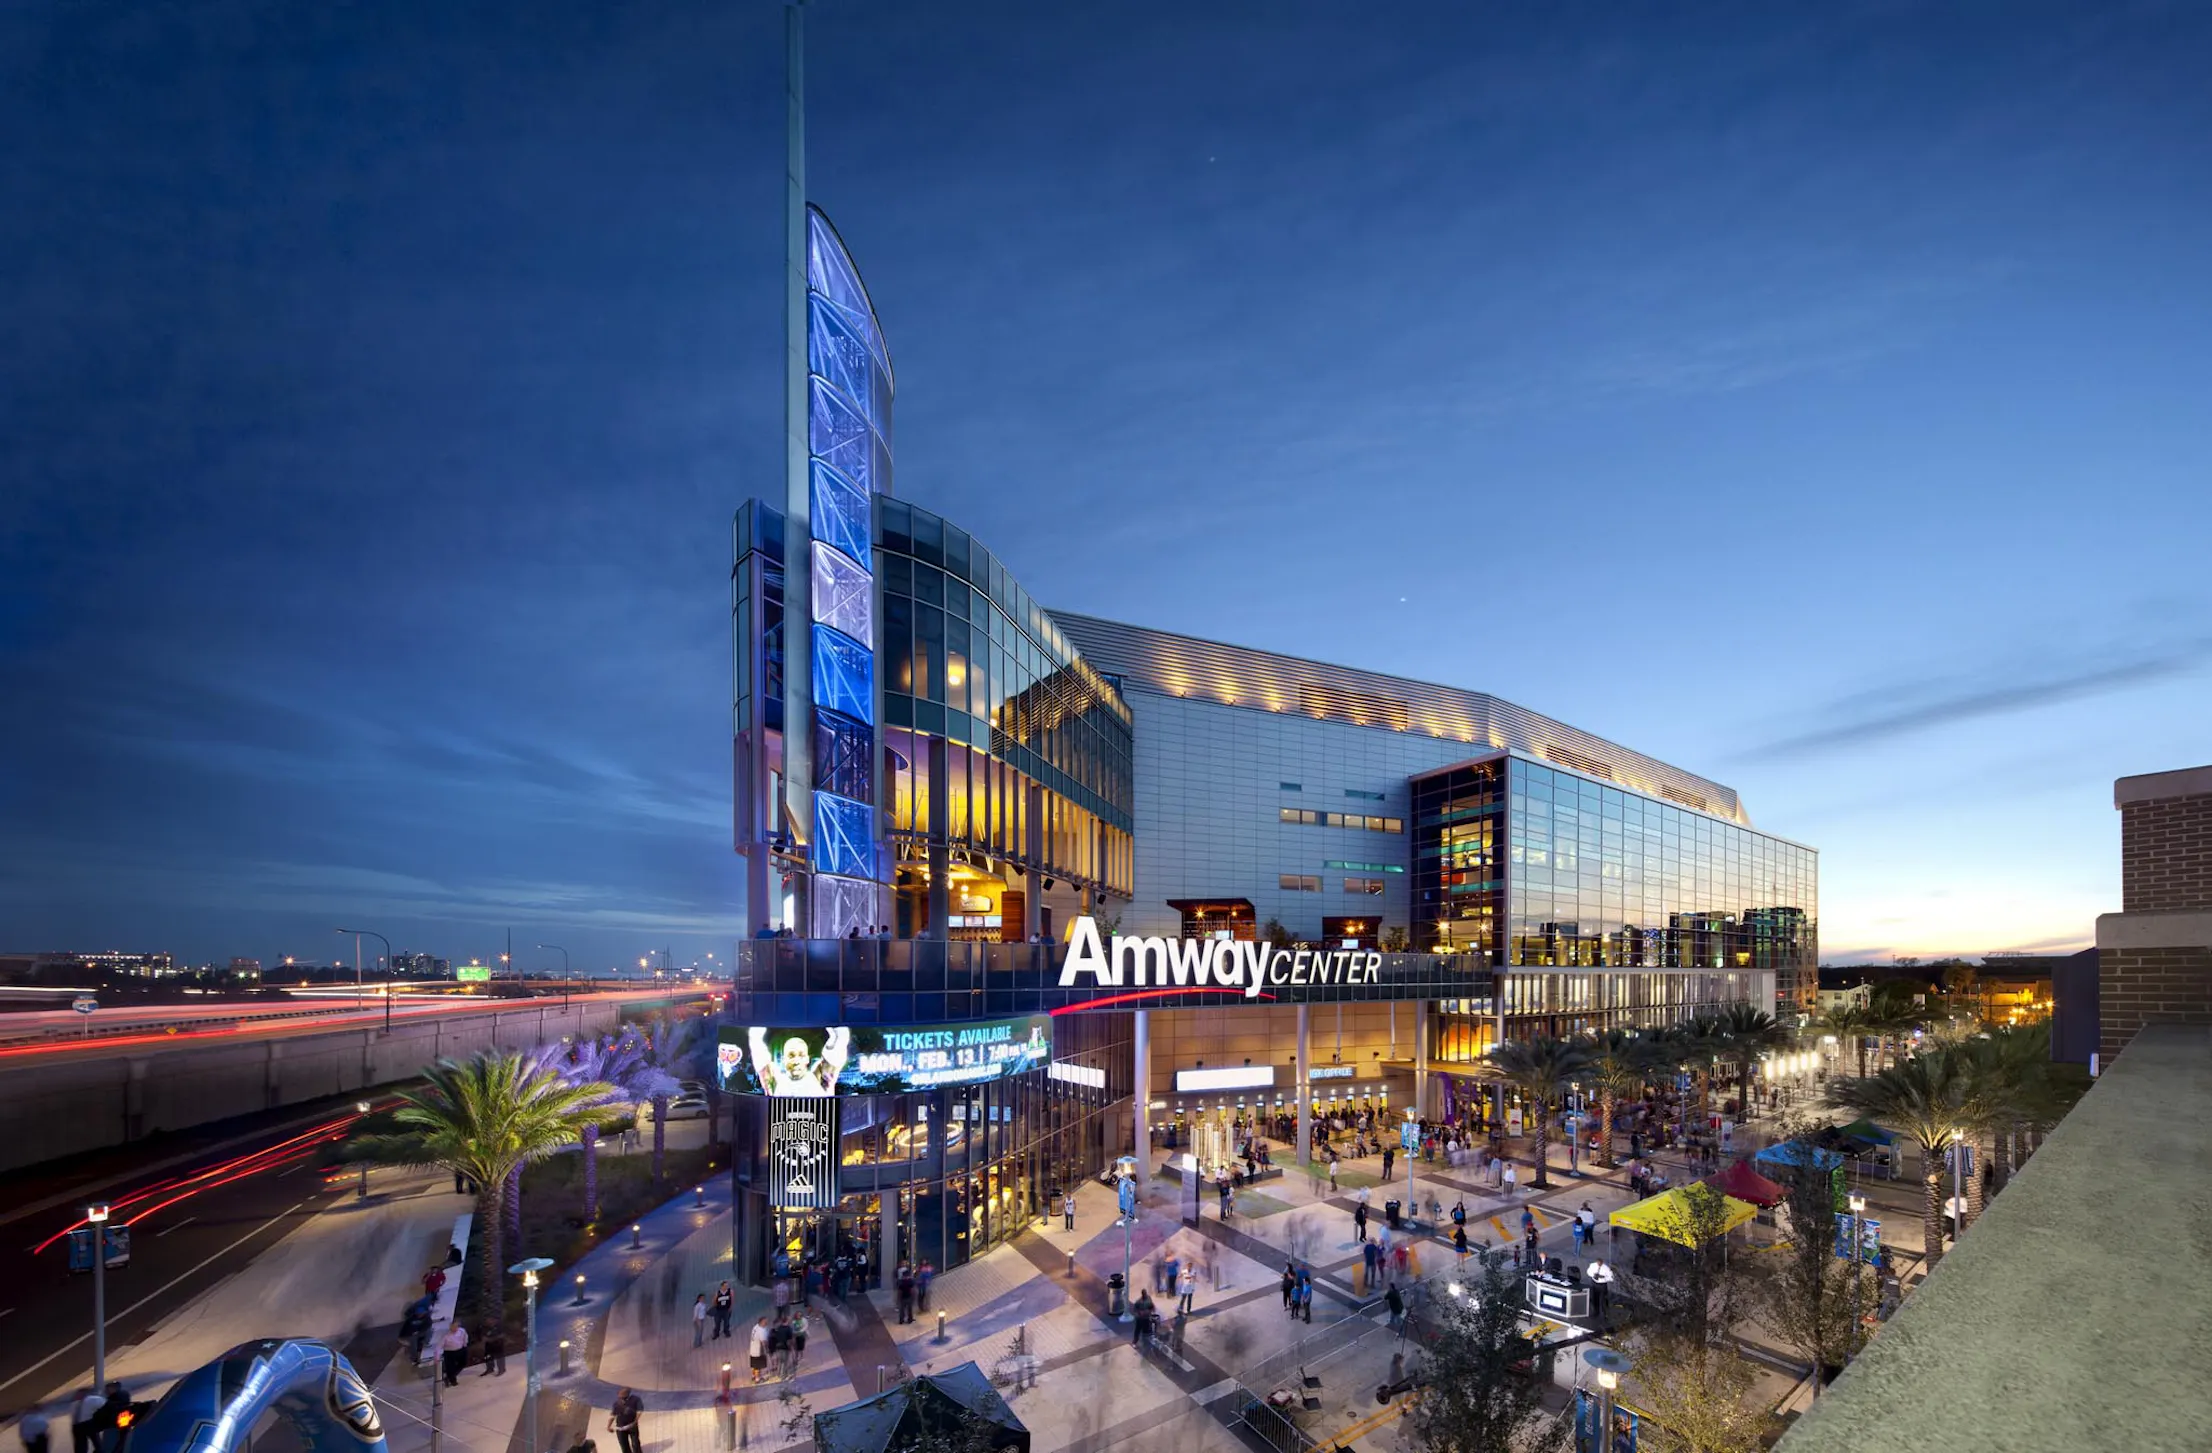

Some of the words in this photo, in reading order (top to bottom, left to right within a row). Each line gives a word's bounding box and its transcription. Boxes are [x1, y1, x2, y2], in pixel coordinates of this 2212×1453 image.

[1058, 916, 1272, 998] Amway
[1270, 950, 1382, 985] CENTER
[882, 1030, 954, 1051] TICKETS
[958, 1025, 1012, 1047] AVAILABLE
[770, 1120, 829, 1144] MAGIC
